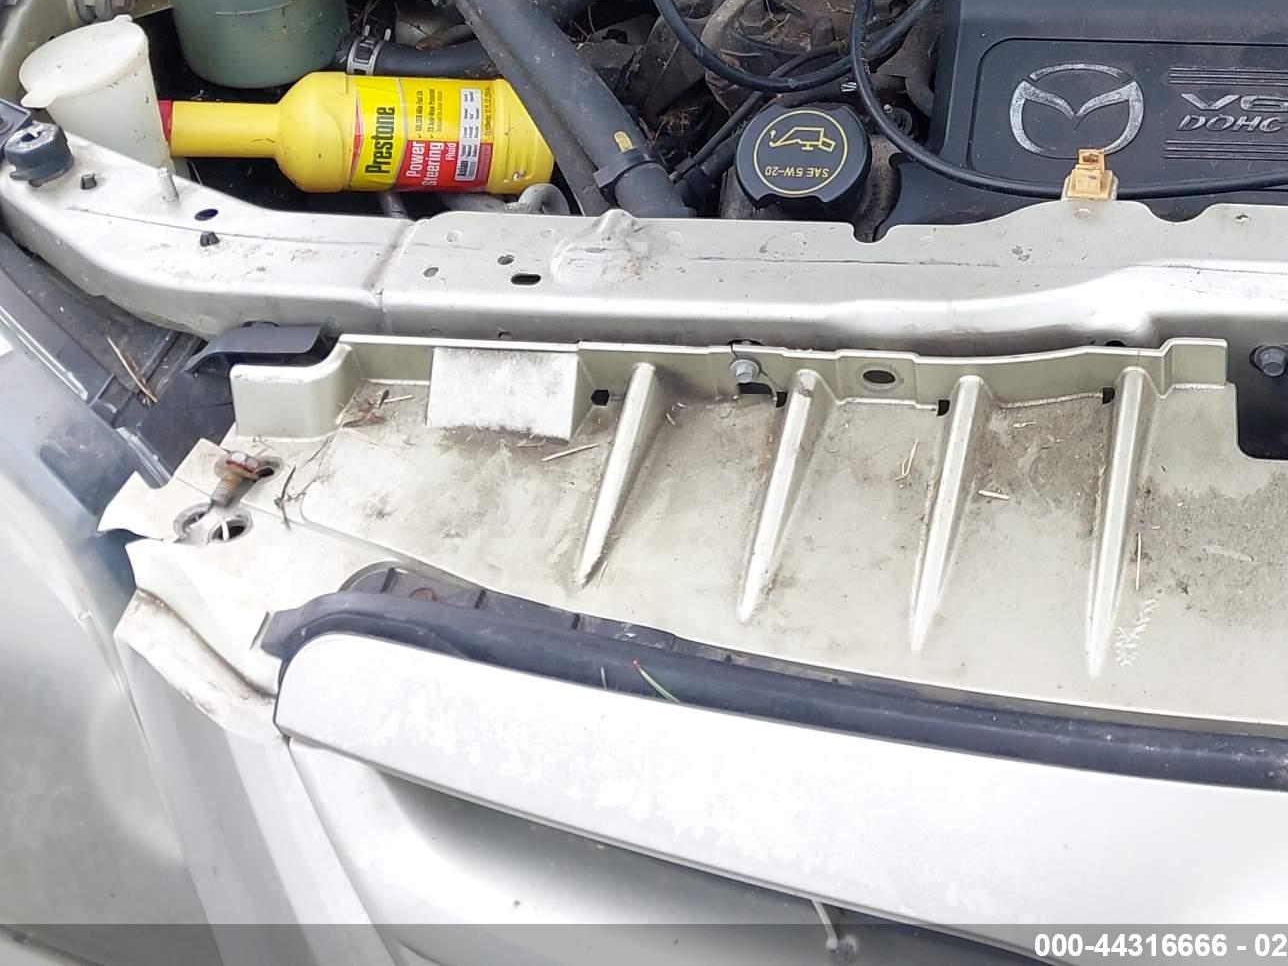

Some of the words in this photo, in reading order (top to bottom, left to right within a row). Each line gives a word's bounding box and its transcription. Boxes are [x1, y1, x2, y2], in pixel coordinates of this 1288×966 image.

[1177, 114, 1285, 133] DOHC
[364, 107, 395, 174] Prestone
[406, 141, 426, 177] Power
[445, 143, 456, 160] Fluid
[422, 142, 444, 186] Steering
[765, 166, 803, 177] 5W-20
[807, 167, 829, 177] SAE
